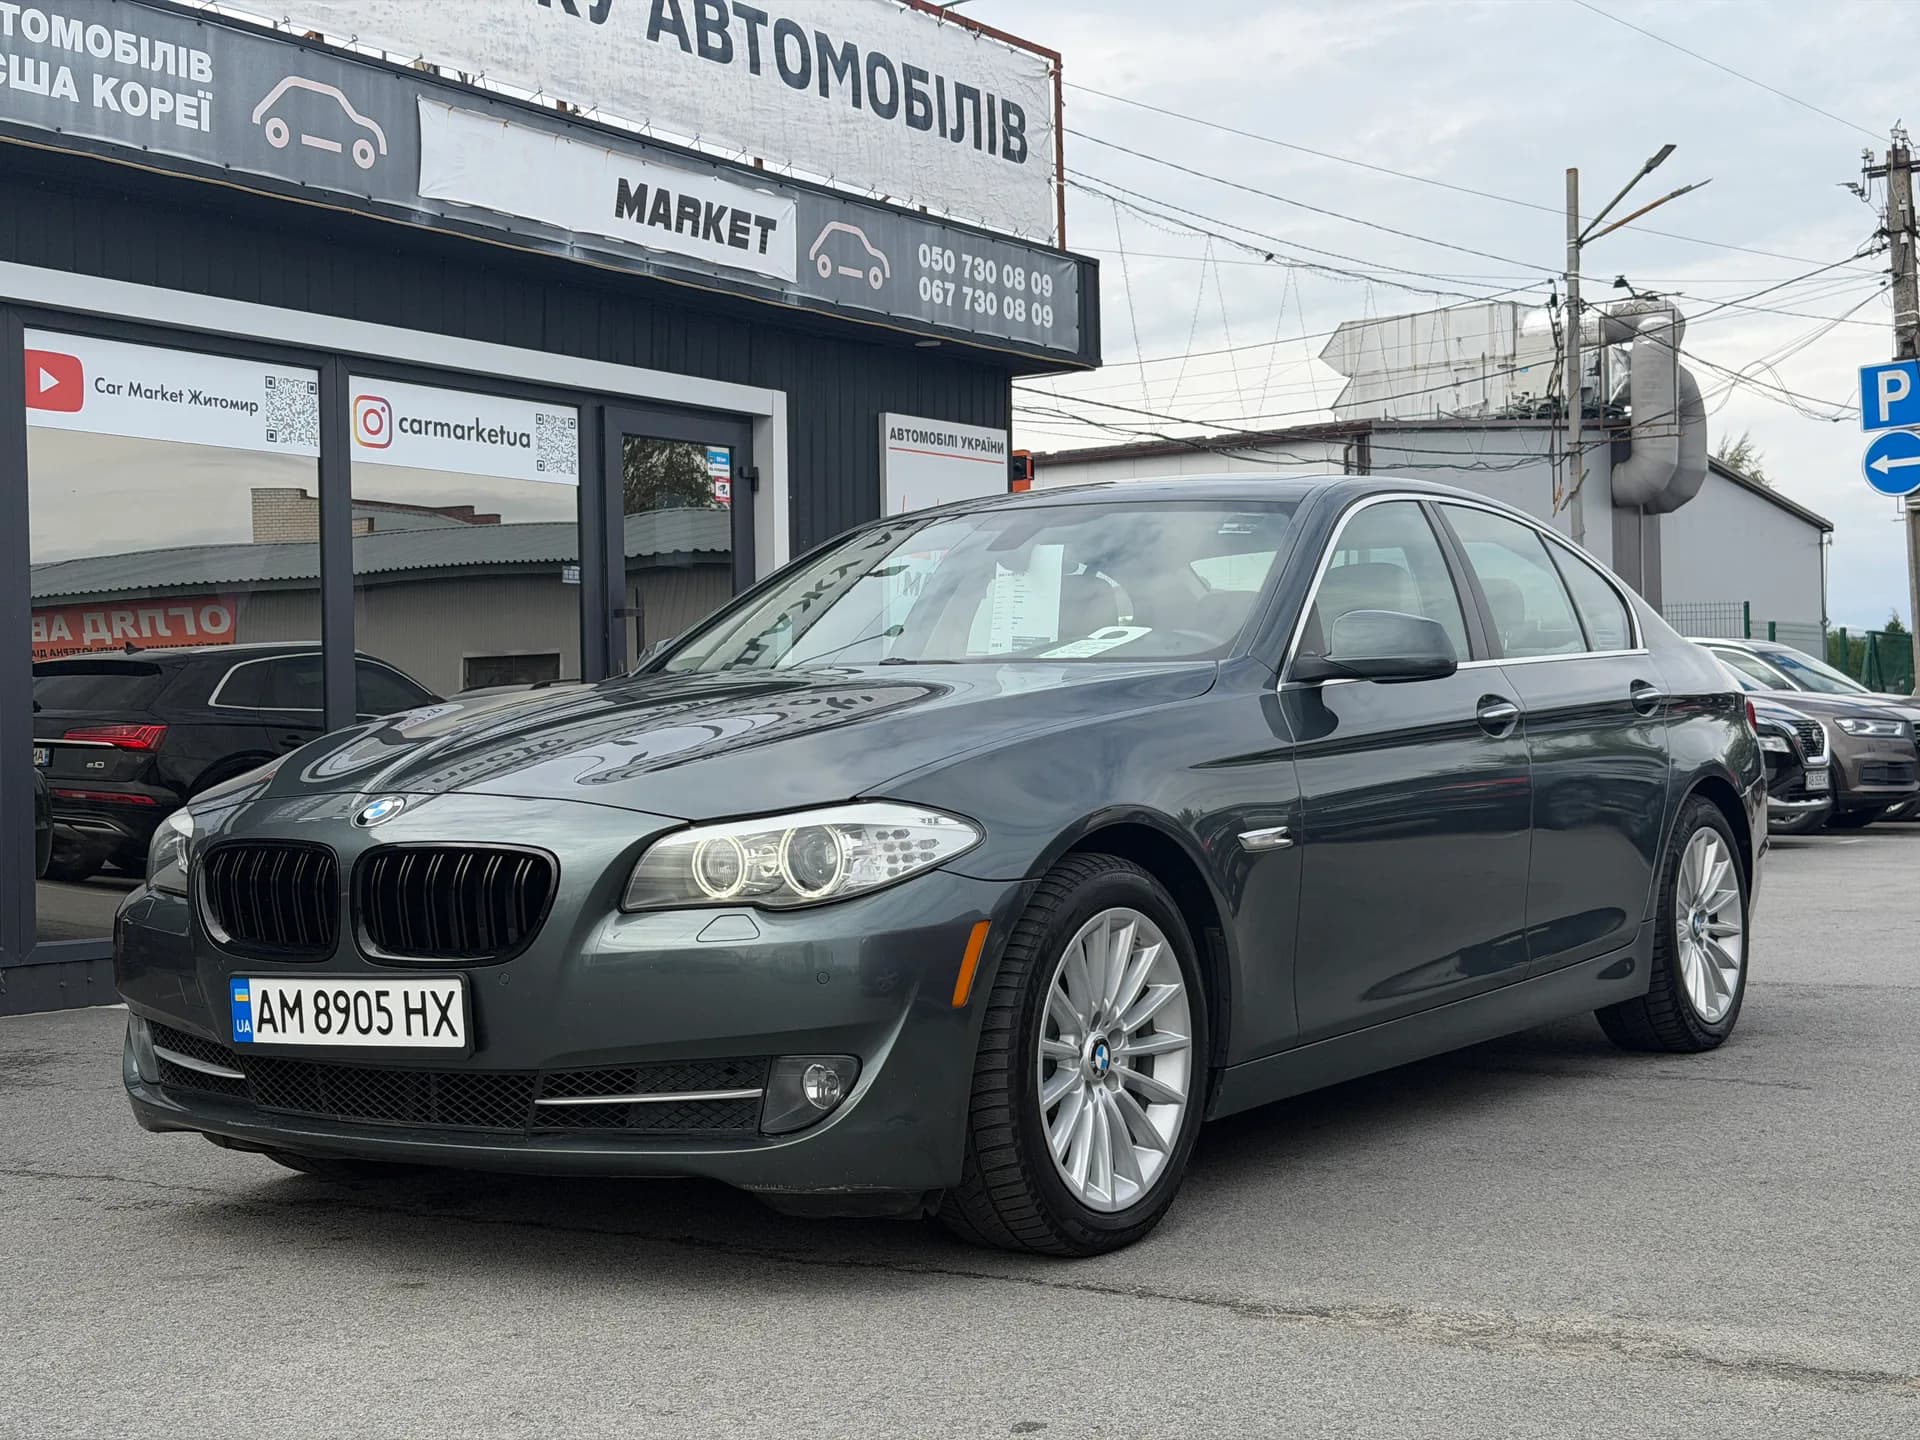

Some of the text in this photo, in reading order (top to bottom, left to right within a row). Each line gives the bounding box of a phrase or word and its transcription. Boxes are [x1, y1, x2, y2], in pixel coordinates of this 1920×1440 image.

[93, 73, 213, 132] КОРЕЇ
[647, 0, 1027, 164] АВТОМОБІЛІВ
[615, 177, 777, 255] MARKET
[918, 243, 1053, 298] 050 730 08 09
[918, 276, 1054, 328] 067 730 08 09
[94, 377, 259, 416] Car Market Житомир
[1877, 369, 1911, 422] P
[398, 416, 531, 449] carmarketua
[889, 427, 1004, 455] АВТОМОБІЛІ УКРАЇНИ
[236, 1019, 251, 1033] UA
[257, 989, 459, 1037] AM 8905 HX
